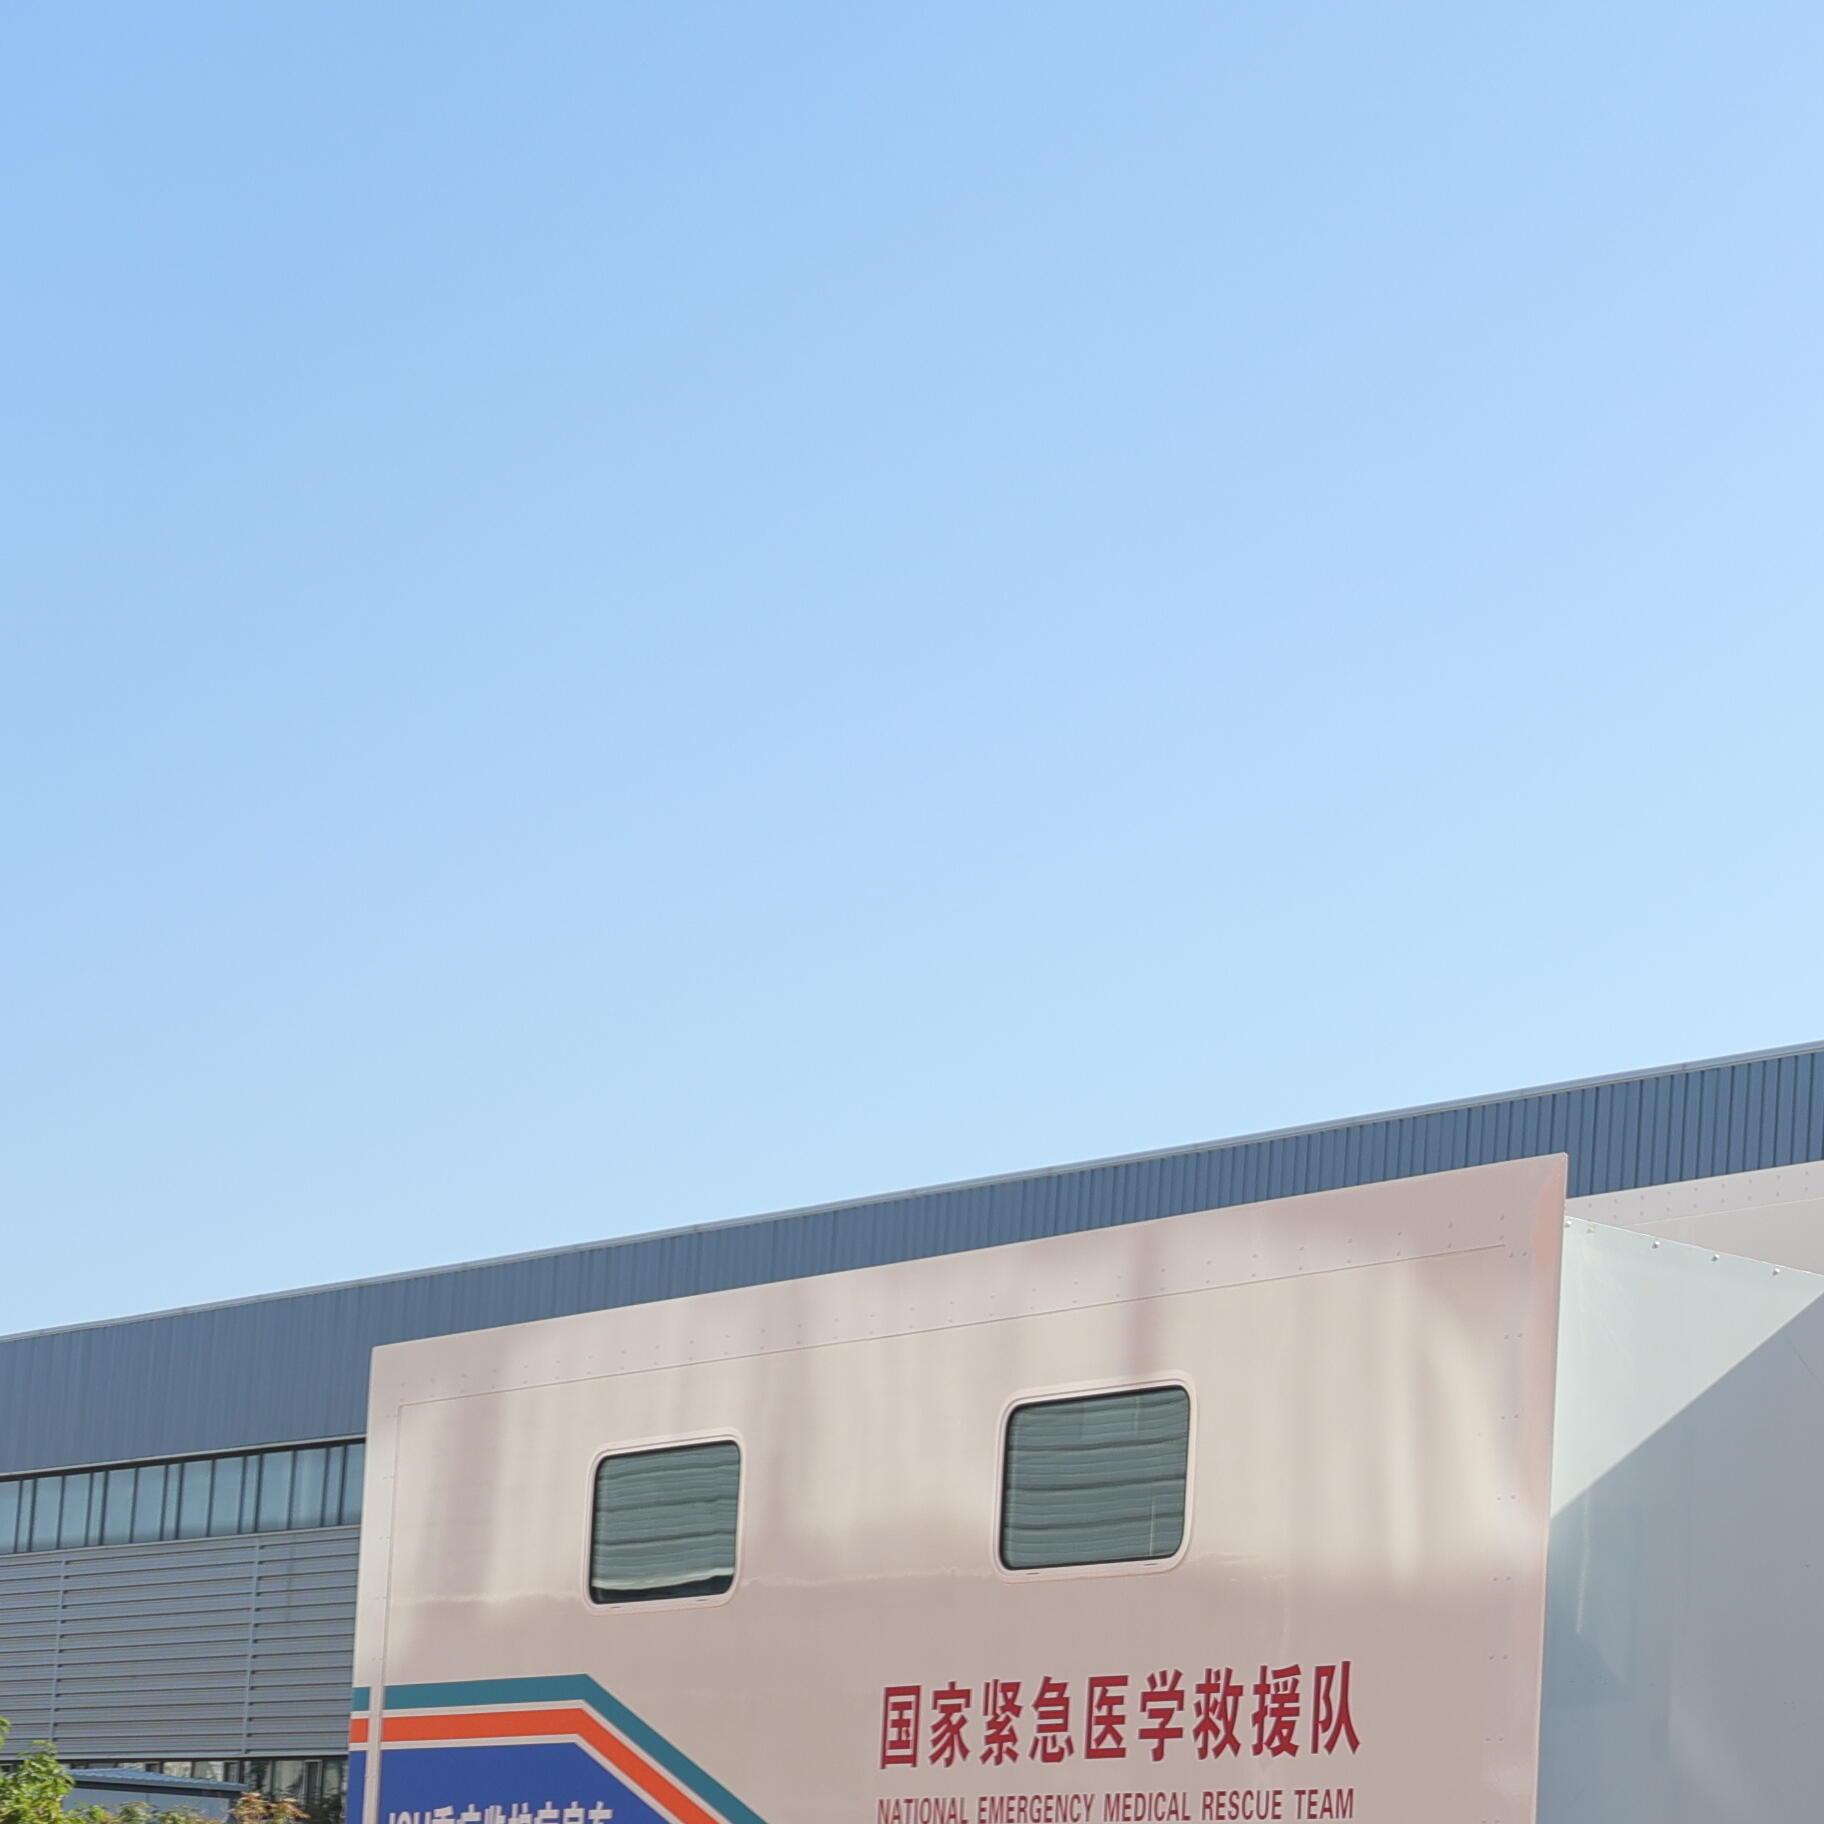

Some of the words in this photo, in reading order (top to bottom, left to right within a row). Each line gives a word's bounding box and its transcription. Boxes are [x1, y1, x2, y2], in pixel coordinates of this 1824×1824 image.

[879, 1660, 1360, 1770] 国家紧急医学救援队
[977, 1793, 1096, 1824] EMERGENCY
[1103, 1791, 1192, 1823] MEDICAL
[1201, 1789, 1284, 1821] RESCUE
[1293, 1788, 1355, 1820] TEAM
